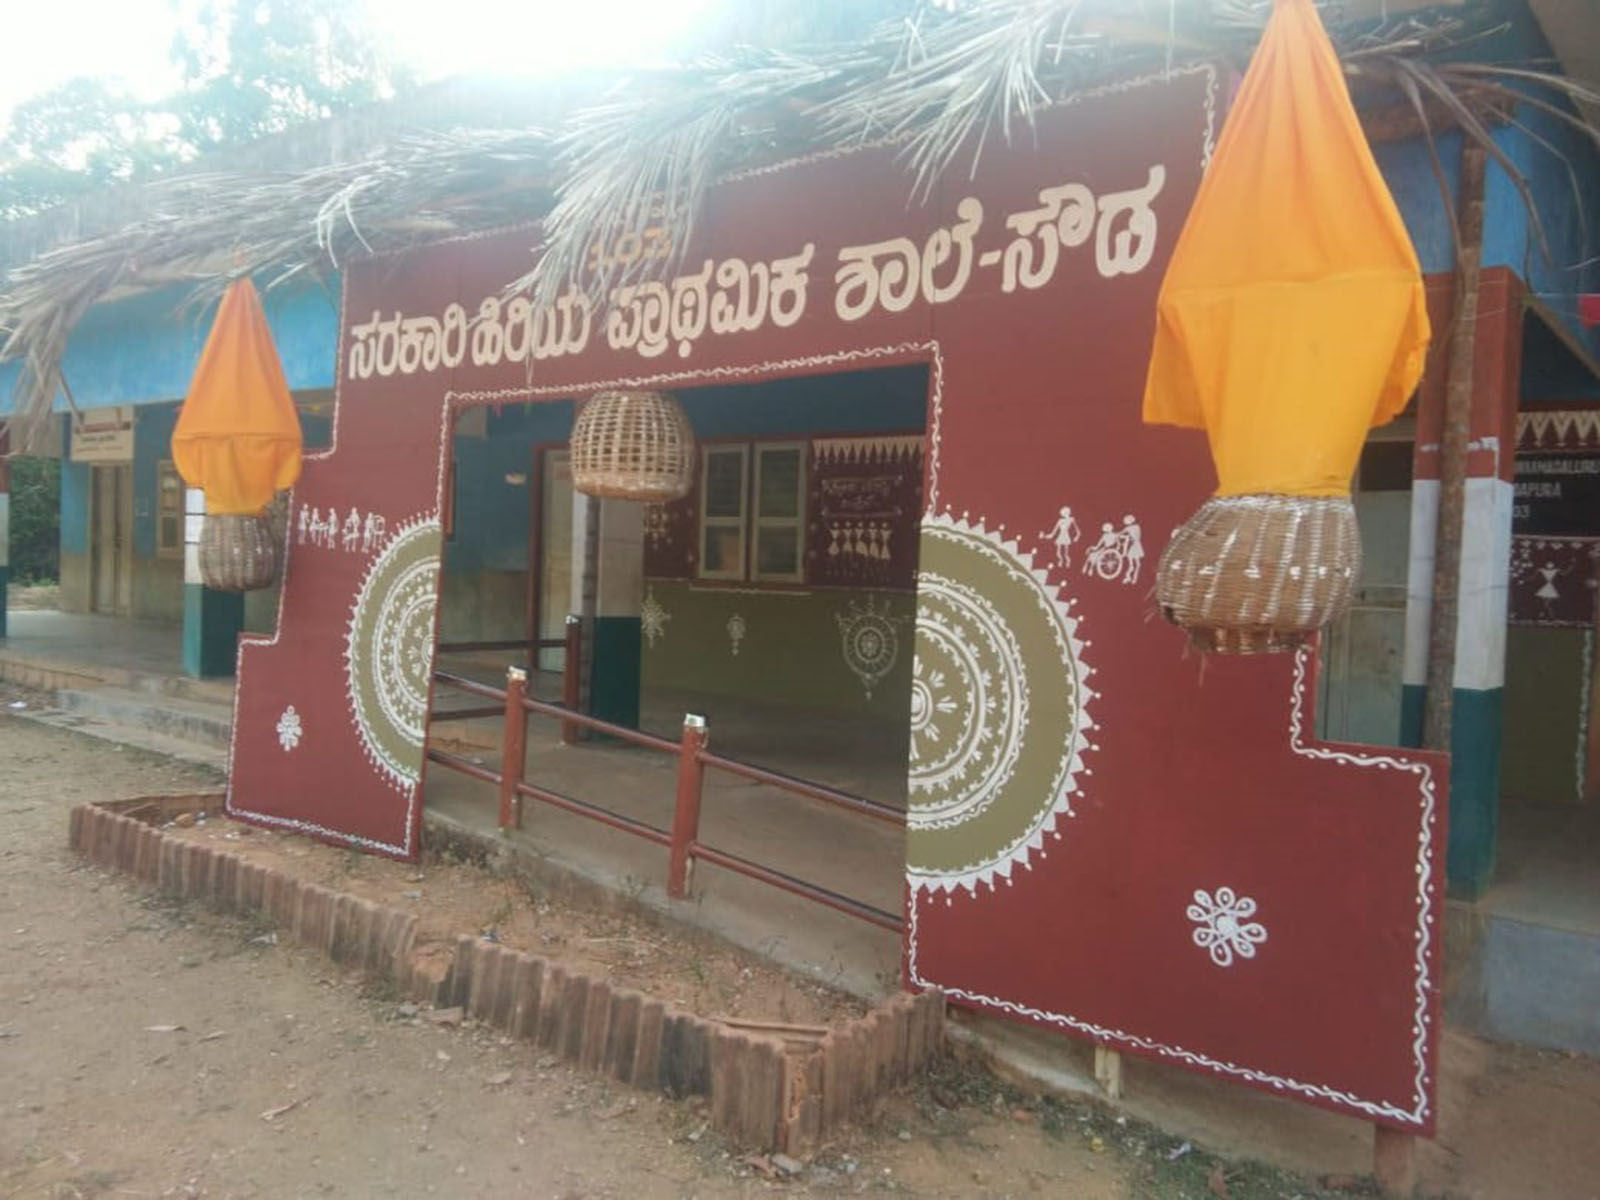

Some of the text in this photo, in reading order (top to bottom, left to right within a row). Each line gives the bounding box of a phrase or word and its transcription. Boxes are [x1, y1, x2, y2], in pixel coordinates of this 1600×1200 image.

[349, 303, 467, 380] ಸರಕಾರಿ
[471, 285, 591, 367] ಹಿರಿಯ
[607, 243, 815, 358] ಪ್ರಾಥಮಿಕ
